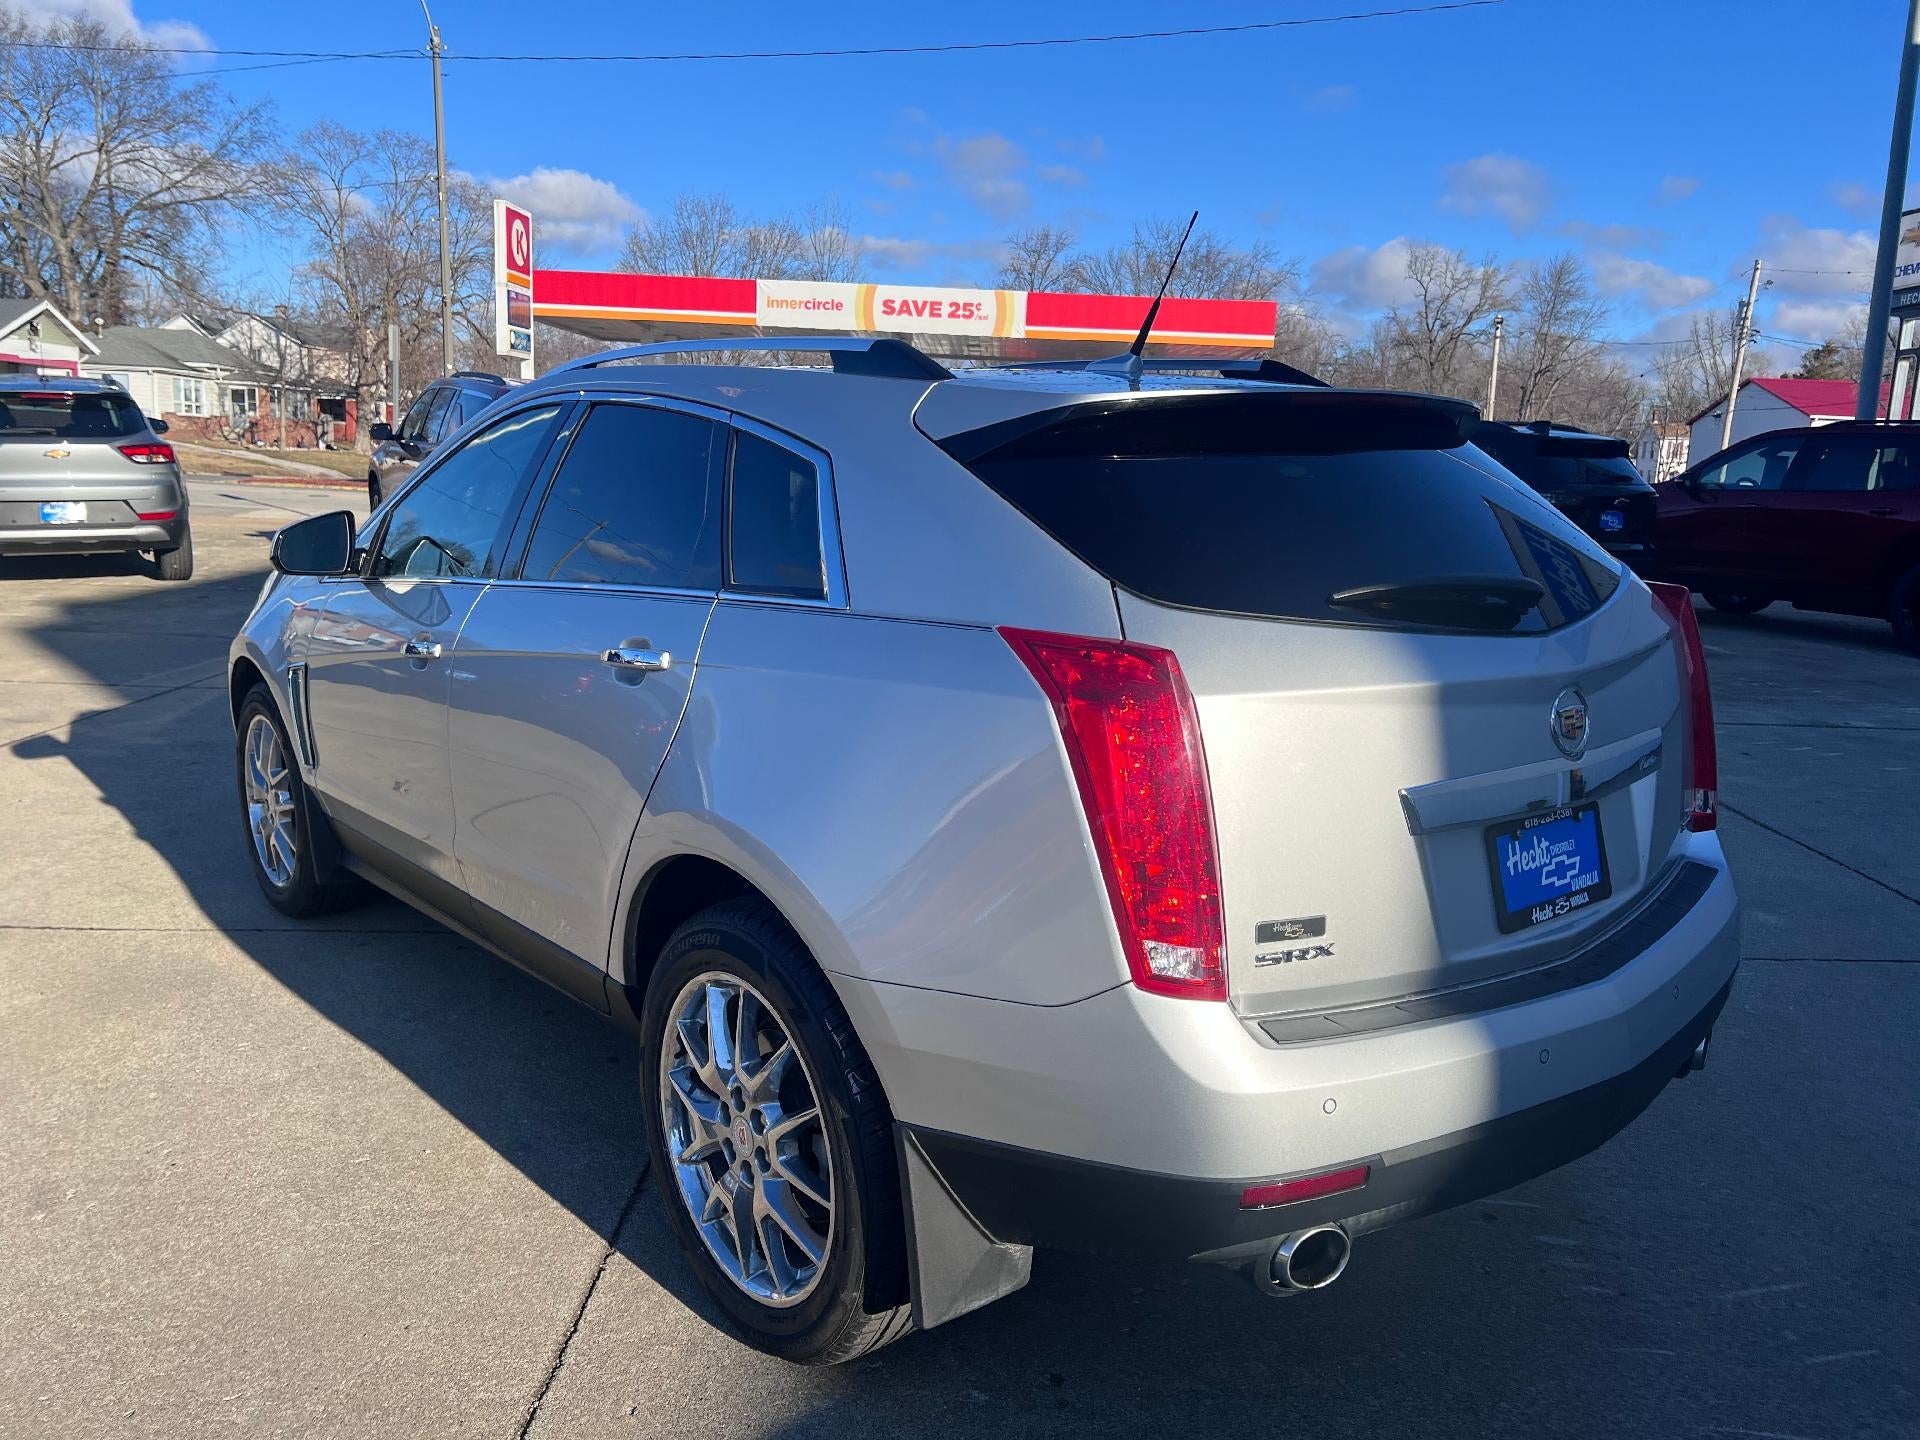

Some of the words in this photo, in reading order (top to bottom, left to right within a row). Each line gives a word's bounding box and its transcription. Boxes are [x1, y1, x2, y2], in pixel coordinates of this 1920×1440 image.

[516, 228, 526, 264] K
[767, 295, 844, 312] innercircle
[881, 298, 943, 319] SAVE
[1901, 292, 1920, 304] HEC
[1507, 835, 1551, 876] Hecht
[1532, 904, 1553, 923] Hecht
[1255, 943, 1335, 968] SRX
